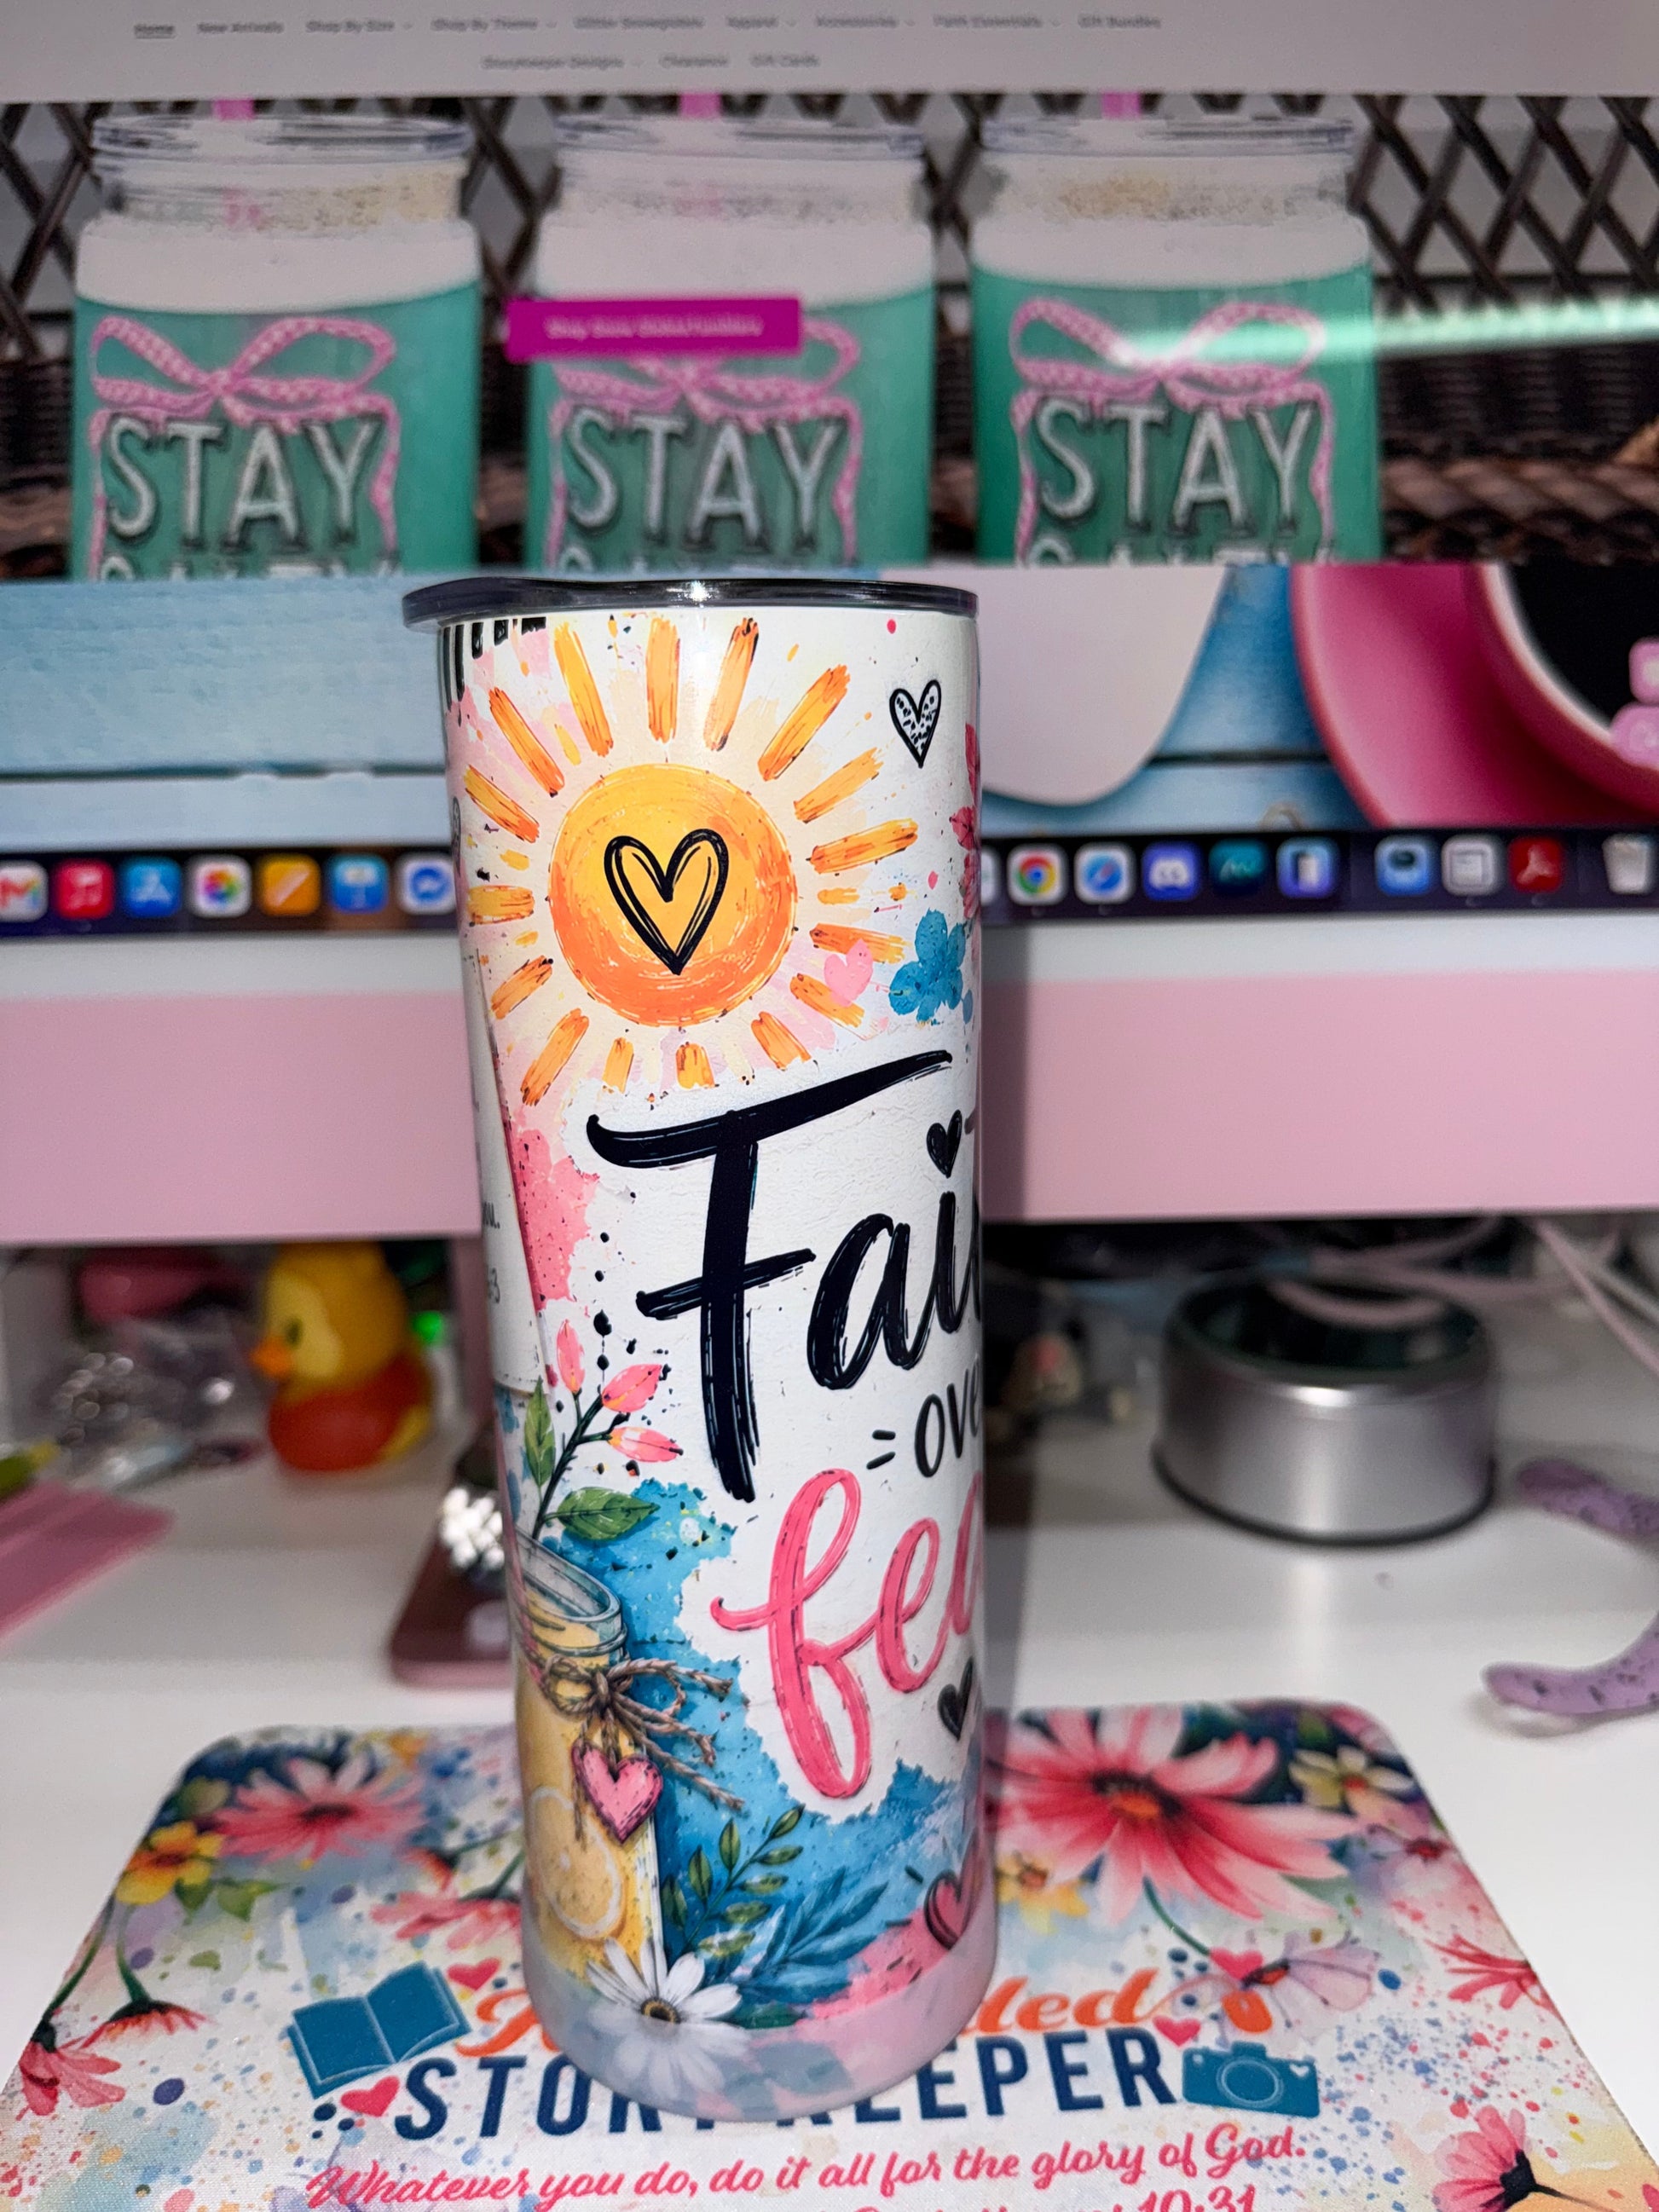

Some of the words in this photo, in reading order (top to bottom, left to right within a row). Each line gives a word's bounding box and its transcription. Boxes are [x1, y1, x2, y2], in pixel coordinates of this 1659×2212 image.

[107, 414, 381, 543] STAY
[569, 407, 846, 540] STAY
[1034, 396, 1318, 530] STAY
[587, 1049, 981, 1503] Fai
[915, 1354, 982, 1477] ove
[710, 1469, 983, 1799] fea
[963, 1967, 1160, 2036] led
[394, 2026, 1177, 2141] STOEPER
[306, 2160, 530, 2209] Whatever
[535, 2168, 625, 2212] you
[634, 2163, 698, 2198] do,
[710, 2159, 765, 2193] do
[776, 2156, 811, 2191] it
[818, 2153, 876, 2189] all
[879, 2151, 942, 2198] for
[953, 2146, 1020, 2182] the
[1031, 2140, 1147, 2190] glory
[1158, 2133, 1199, 2179] of
[1205, 2122, 1307, 2180] God.
